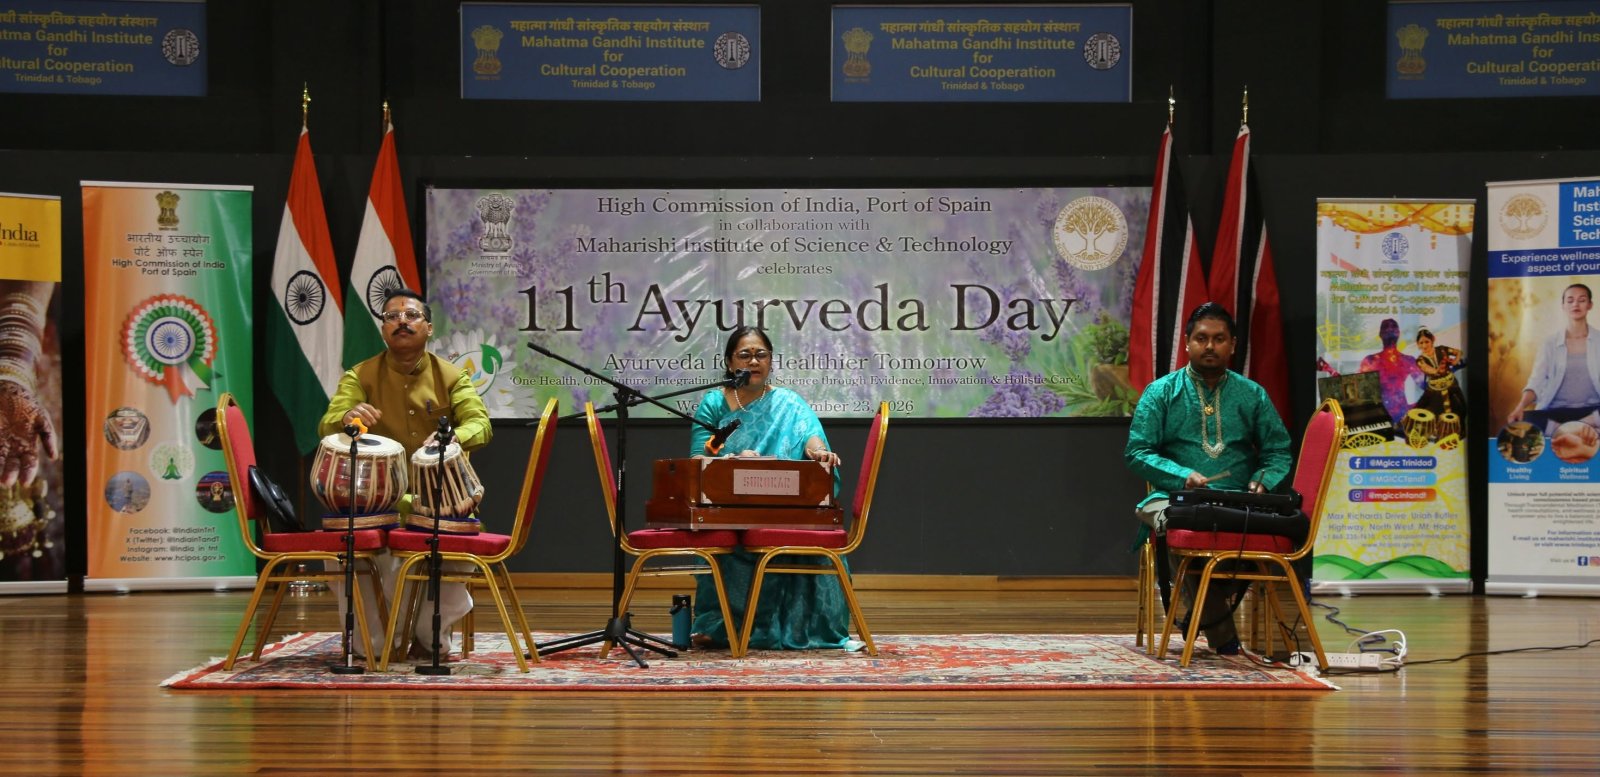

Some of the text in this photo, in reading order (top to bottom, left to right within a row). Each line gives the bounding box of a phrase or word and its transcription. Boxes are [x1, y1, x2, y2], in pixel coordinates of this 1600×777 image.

[78, 14, 117, 27] सहयोग
[633, 19, 670, 32] सहयोग
[1003, 20, 1041, 33] सहयोग
[35, 30, 87, 43] Gandhi
[92, 32, 153, 45] Institute
[521, 36, 705, 49] Mahatma Gandhi Institute
[892, 37, 1076, 50] Mahatma Gandhi Institute
[1448, 33, 1517, 45] Mahatma
[1522, 31, 1573, 44] Gandhi
[48, 44, 68, 56] for
[603, 50, 623, 62] for
[1532, 46, 1554, 58] for
[973, 52, 993, 64] for
[44, 59, 133, 73] Cooperation
[541, 64, 686, 80] Cultural Cooperation
[1466, 61, 1524, 73] Cultural
[910, 66, 1056, 81] Cultural Cooperation
[15, 74, 102, 86] Trinidad & Tobago
[572, 80, 656, 90] Trinidad & Tobago
[1499, 76, 1586, 87] Trinidad & Tobago
[941, 81, 1025, 92] Trinidad & Tobago
[597, 197, 992, 216] High Commission of India, Port of Spain
[719, 218, 870, 231] in collaboration with
[577, 236, 1013, 255] Maharishi Institute of Science & Technology
[112, 259, 225, 269] High Commission of India
[1501, 253, 1559, 264] Experience
[173, 268, 197, 277] Spain
[757, 263, 833, 275] celebrates
[1527, 263, 1561, 274] aspect
[1564, 262, 1574, 272] of
[1330, 282, 1462, 292] Mahatma Gandhi Institute
[1331, 294, 1346, 303] for
[1348, 294, 1387, 303] Cultural
[518, 272, 1077, 342] 11th Ayurveda Day
[1392, 306, 1398, 314] &
[1400, 306, 1435, 316] Tobago
[603, 353, 706, 373] Ayurveda
[712, 353, 728, 370] fo
[874, 353, 987, 370] Tomorrow
[539, 375, 580, 387] Health,
[655, 375, 714, 387] Integrating
[775, 375, 816, 385] Science
[821, 375, 867, 387] through
[870, 375, 925, 387] Evidence,
[928, 375, 987, 385] Innovation
[990, 376, 1001, 385] &
[1004, 375, 1048, 385] Holistic
[853, 400, 875, 413] 23,
[888, 400, 914, 412] 026
[1402, 459, 1432, 467] Trinidad
